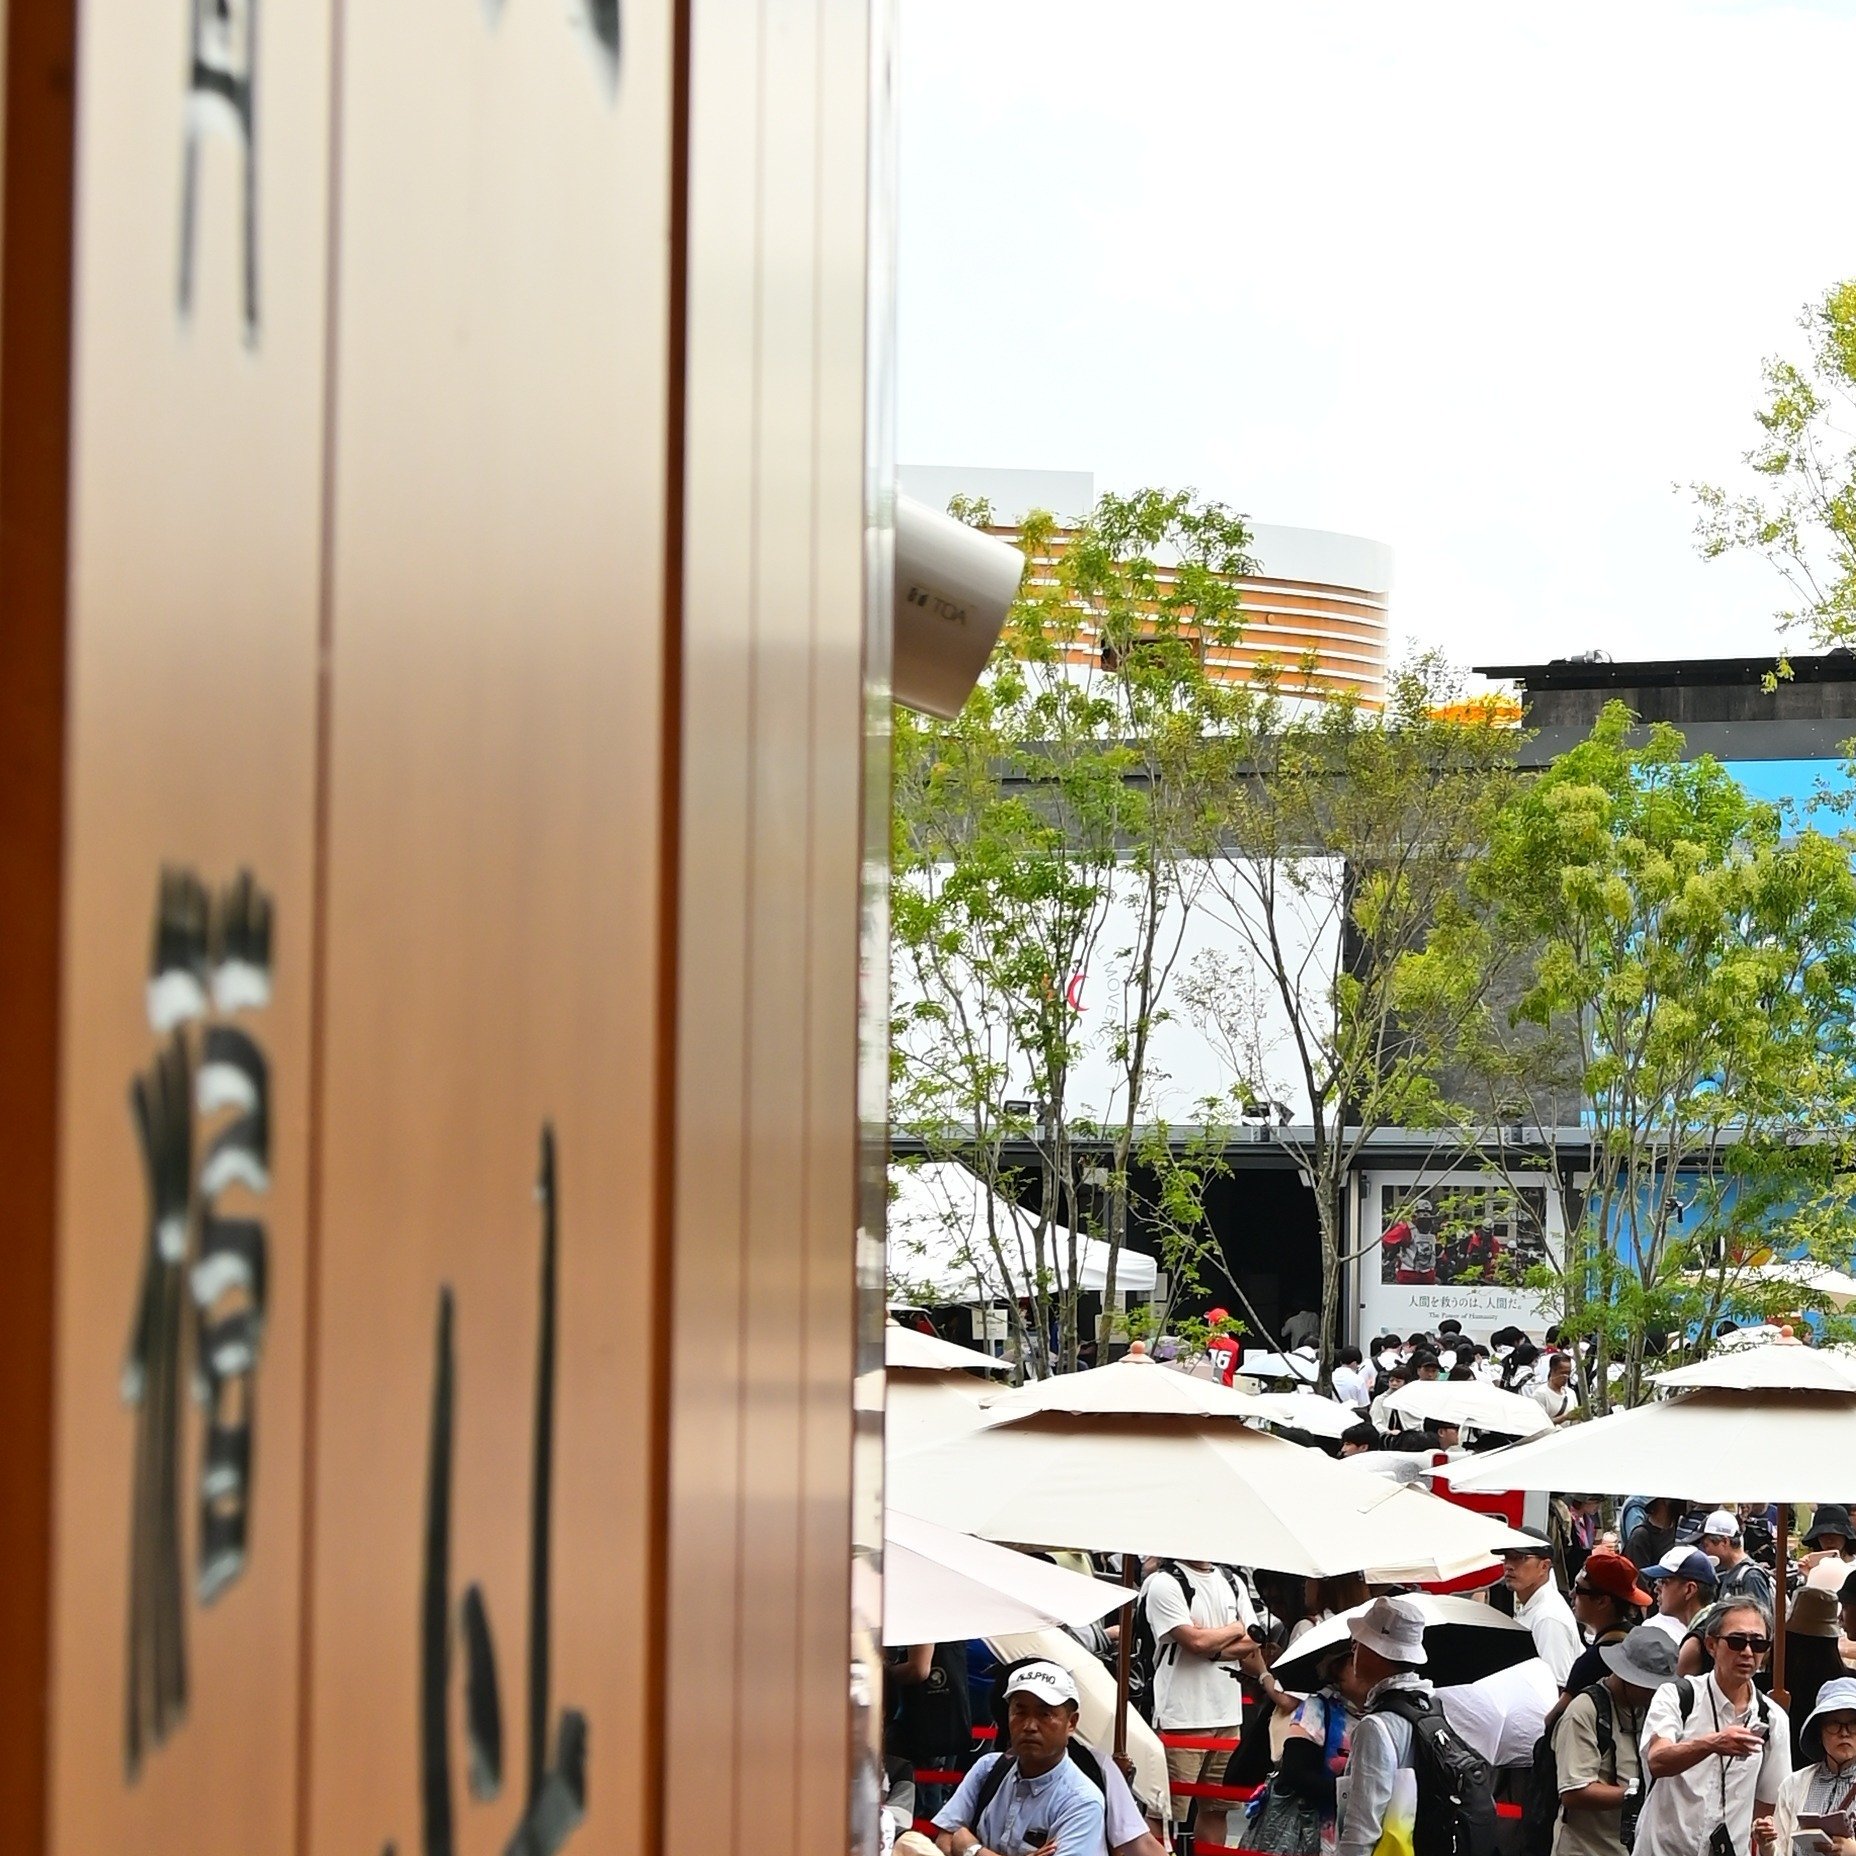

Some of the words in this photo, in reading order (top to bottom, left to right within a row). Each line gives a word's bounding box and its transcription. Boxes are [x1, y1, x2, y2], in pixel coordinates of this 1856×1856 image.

[932, 595, 967, 627] TOA
[1409, 1295, 1522, 1310] 人間を救うのは、人間だ。
